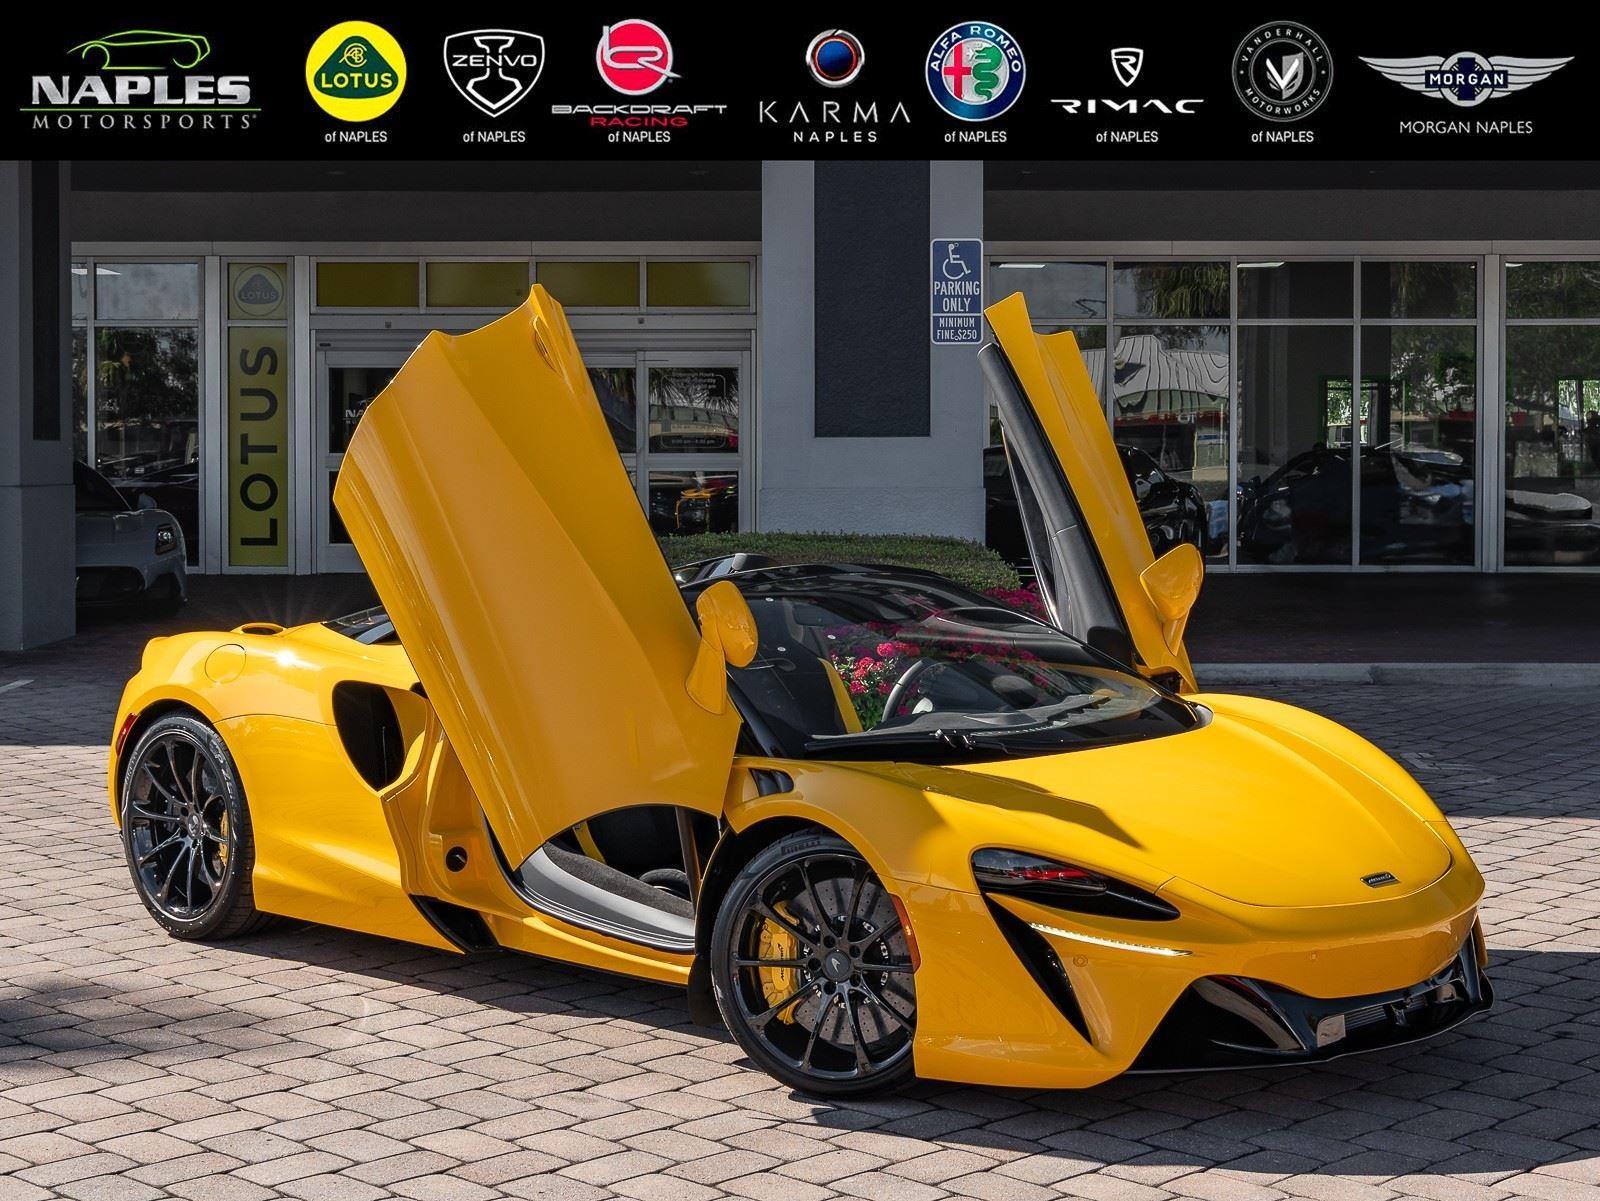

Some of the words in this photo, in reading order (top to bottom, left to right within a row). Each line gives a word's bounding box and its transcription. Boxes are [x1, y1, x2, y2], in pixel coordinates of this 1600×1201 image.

[934, 281, 980, 295] PARKING
[241, 290, 276, 300] LOTUS
[943, 298, 971, 312] ONLY
[939, 317, 975, 328] MINIMUM
[937, 330, 955, 340] FINE
[958, 329, 977, 341] $250
[240, 346, 278, 546] LOTUS
